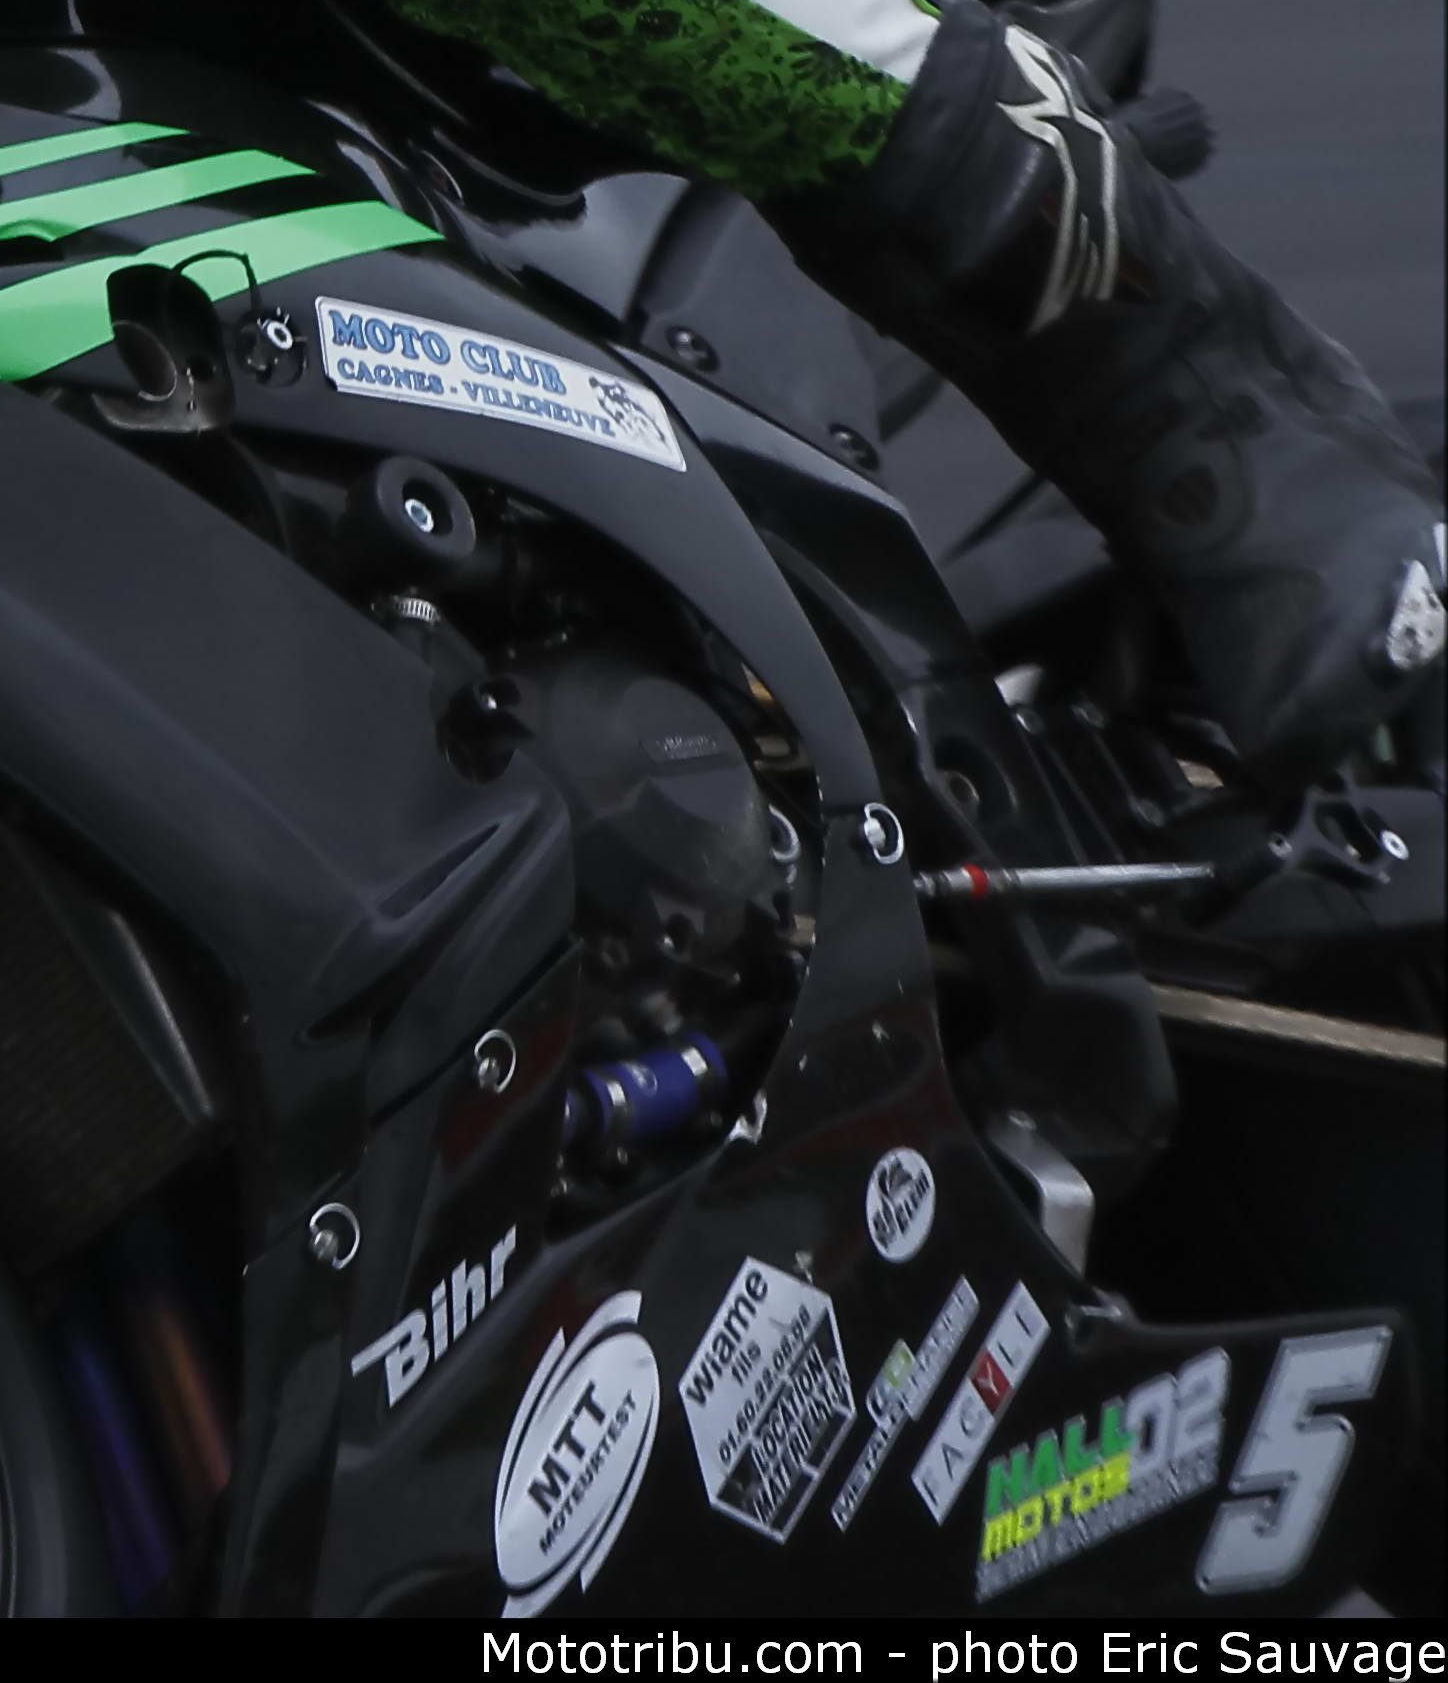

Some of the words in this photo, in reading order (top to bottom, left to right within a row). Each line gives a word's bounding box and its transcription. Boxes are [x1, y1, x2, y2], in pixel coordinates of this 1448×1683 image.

[328, 310, 451, 365] MOTO
[460, 339, 567, 395] CLUB
[336, 357, 445, 395] CAGNES
[461, 379, 616, 438] VILLENEUVE
[351, 1223, 518, 1409] Bihr
[526, 1380, 607, 1516] MTT
[538, 1388, 637, 1557] MOTEURTEST
[750, 1341, 824, 1472] LOCATION
[985, 1397, 1136, 1519] HALL
[1195, 1325, 1393, 1595] 5
